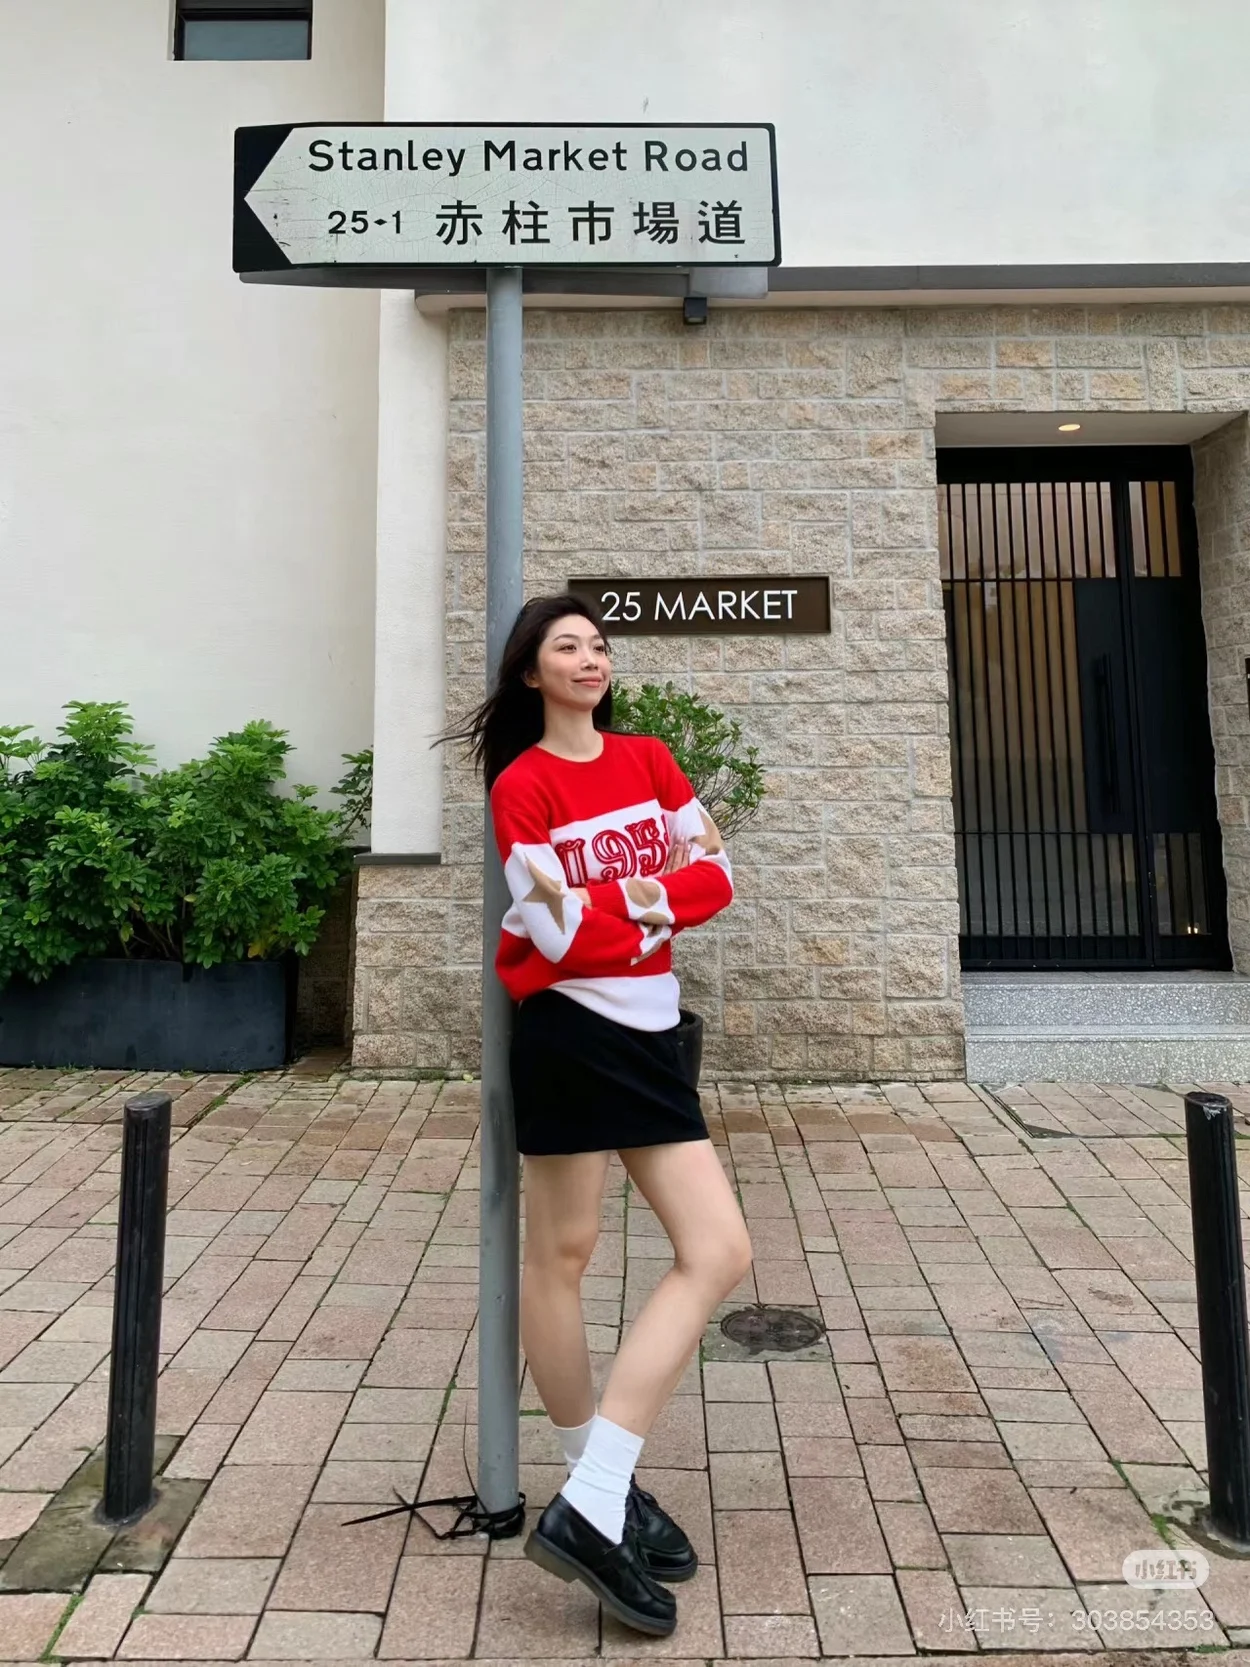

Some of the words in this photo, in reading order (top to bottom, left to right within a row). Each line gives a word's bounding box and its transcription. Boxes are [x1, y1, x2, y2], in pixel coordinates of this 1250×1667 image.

[308, 140, 465, 176] Stanley
[484, 140, 627, 171] Market
[644, 140, 749, 171] Road
[435, 200, 746, 245] 赤柱市場道
[601, 591, 642, 621] 25
[654, 590, 798, 620] MARKET
[554, 814, 670, 888] 195
